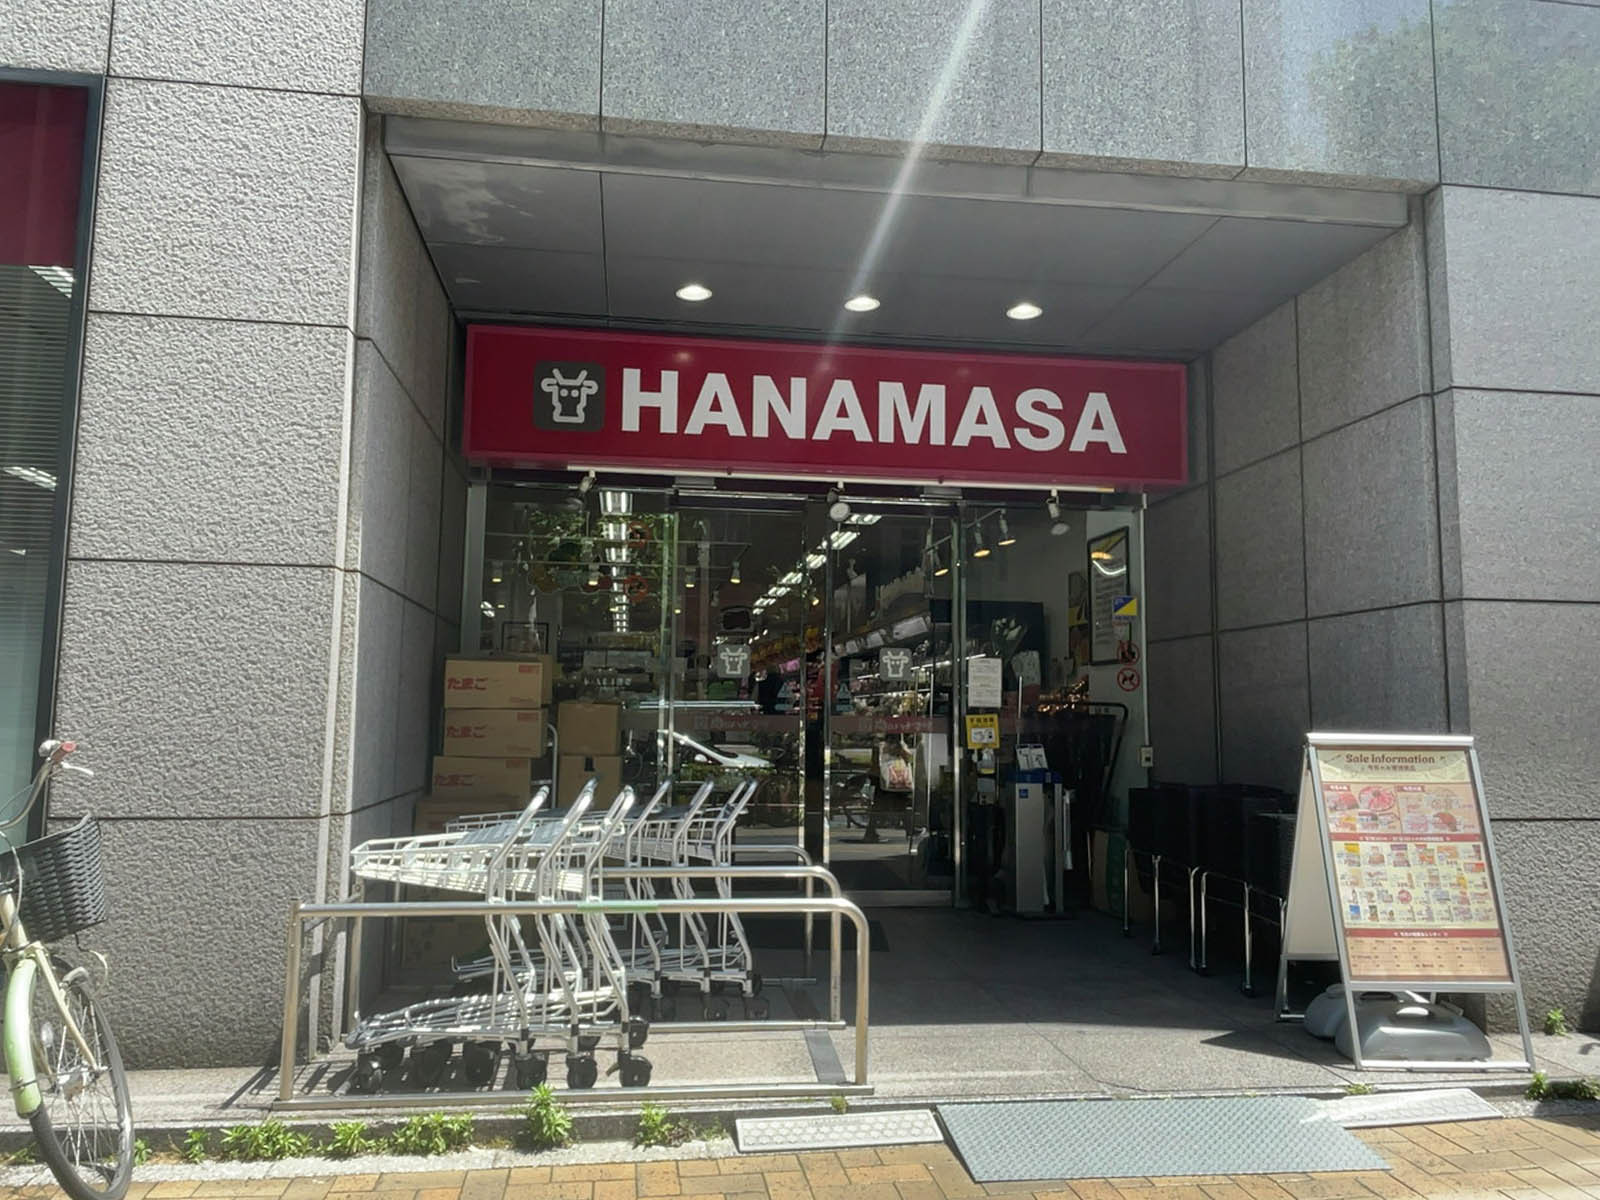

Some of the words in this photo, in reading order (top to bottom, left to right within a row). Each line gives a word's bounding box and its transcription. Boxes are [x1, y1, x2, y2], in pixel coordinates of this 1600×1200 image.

[621, 367, 1127, 454] HANAMASA
[447, 677, 488, 691] たまご
[447, 725, 487, 739] たまご
[1345, 753, 1369, 763] Sale
[434, 774, 474, 786] たまご
